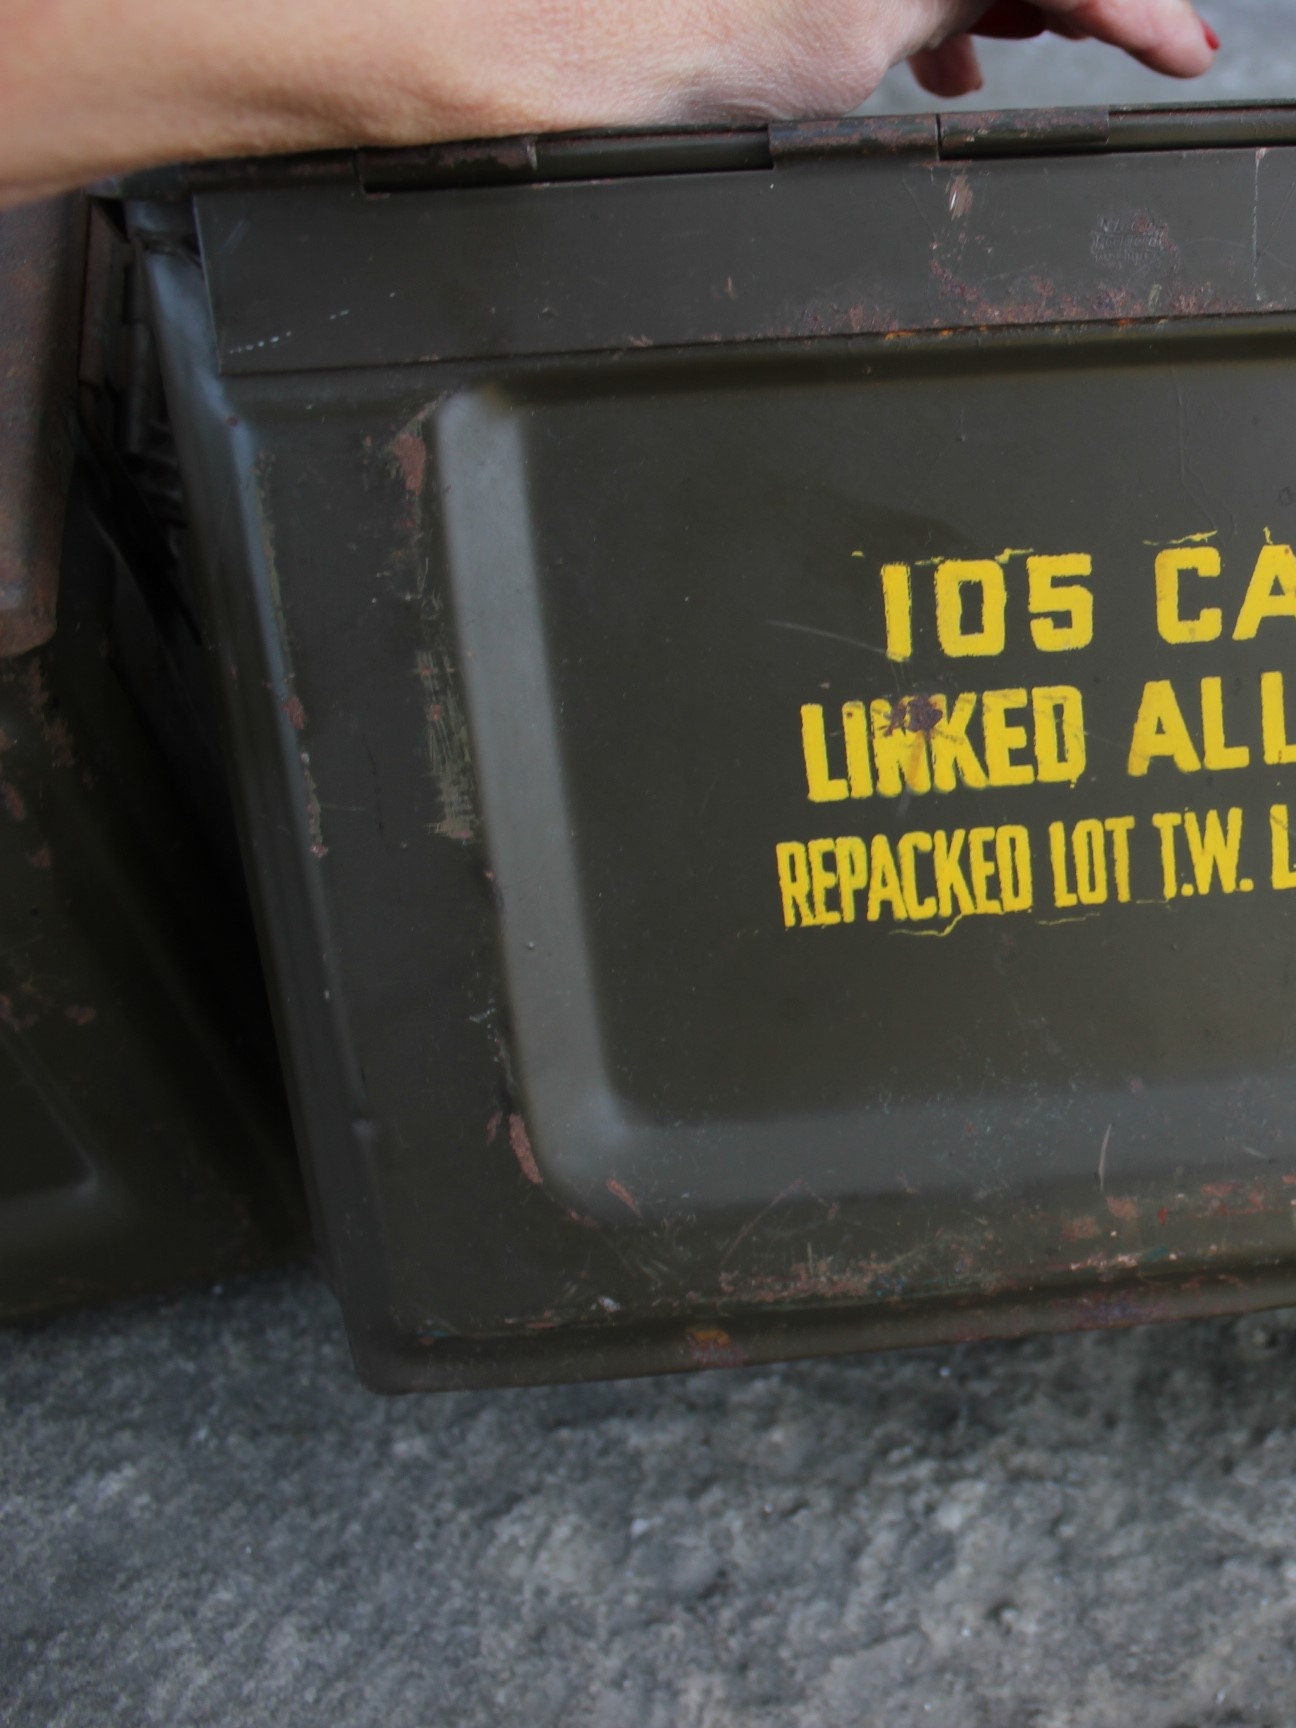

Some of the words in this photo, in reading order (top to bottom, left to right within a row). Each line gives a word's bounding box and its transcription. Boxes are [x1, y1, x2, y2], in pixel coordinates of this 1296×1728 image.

[880, 552, 1094, 662] 105
[800, 685, 1087, 803] LINKED
[776, 825, 1034, 928] REPACKED
[1049, 815, 1136, 908] LOT
